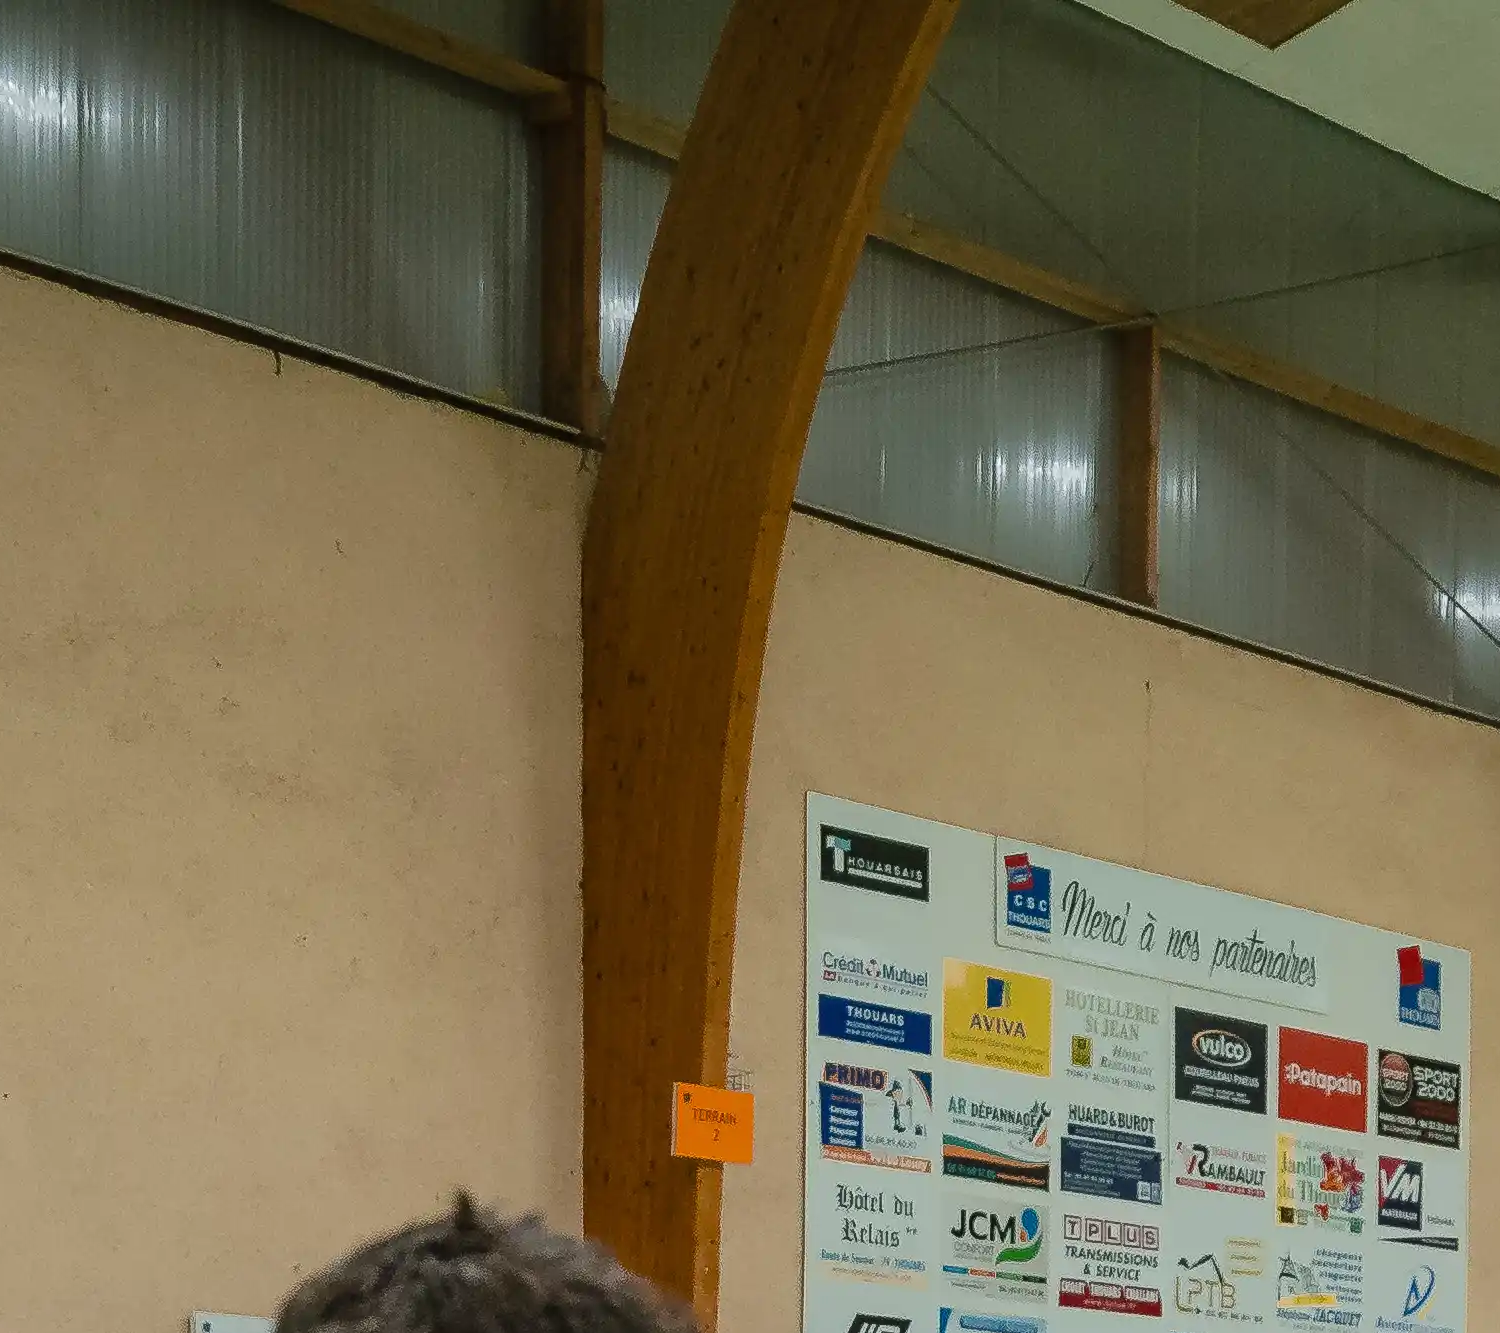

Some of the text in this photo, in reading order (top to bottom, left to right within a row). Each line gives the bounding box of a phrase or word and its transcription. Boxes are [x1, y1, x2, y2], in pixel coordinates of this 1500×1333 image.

[826, 835, 923, 881] THOUARSAIS
[1061, 880, 1319, 988] Merci à nos partenaires
[822, 951, 929, 988] Crédit Mutuel
[846, 1005, 905, 1027] THOUARS
[1065, 988, 1160, 1026] HOTELLERIE
[970, 1013, 1027, 1039] AVIVA
[1100, 1018, 1140, 1042] JEAN
[1200, 1035, 1244, 1061] vulco
[824, 1062, 886, 1090] PRIMO
[1288, 1063, 1362, 1097] Patapain
[1412, 1065, 1459, 1087] SPORT
[1416, 1081, 1456, 1101] 2000
[692, 1106, 738, 1125] TERRAIN
[948, 1096, 967, 1115] AR
[971, 1100, 1041, 1128] DÉPANNAGE
[712, 1129, 720, 1142] 2
[1186, 1143, 1267, 1187] RAMBAULT
[1378, 1163, 1421, 1203] VM
[835, 1183, 915, 1218] Hôtel du
[841, 1217, 901, 1248] Relais
[951, 1208, 1016, 1244] JCM
[1065, 1245, 1159, 1269] TRANSMISSIONS
[1083, 1263, 1141, 1283] & SERVICE
